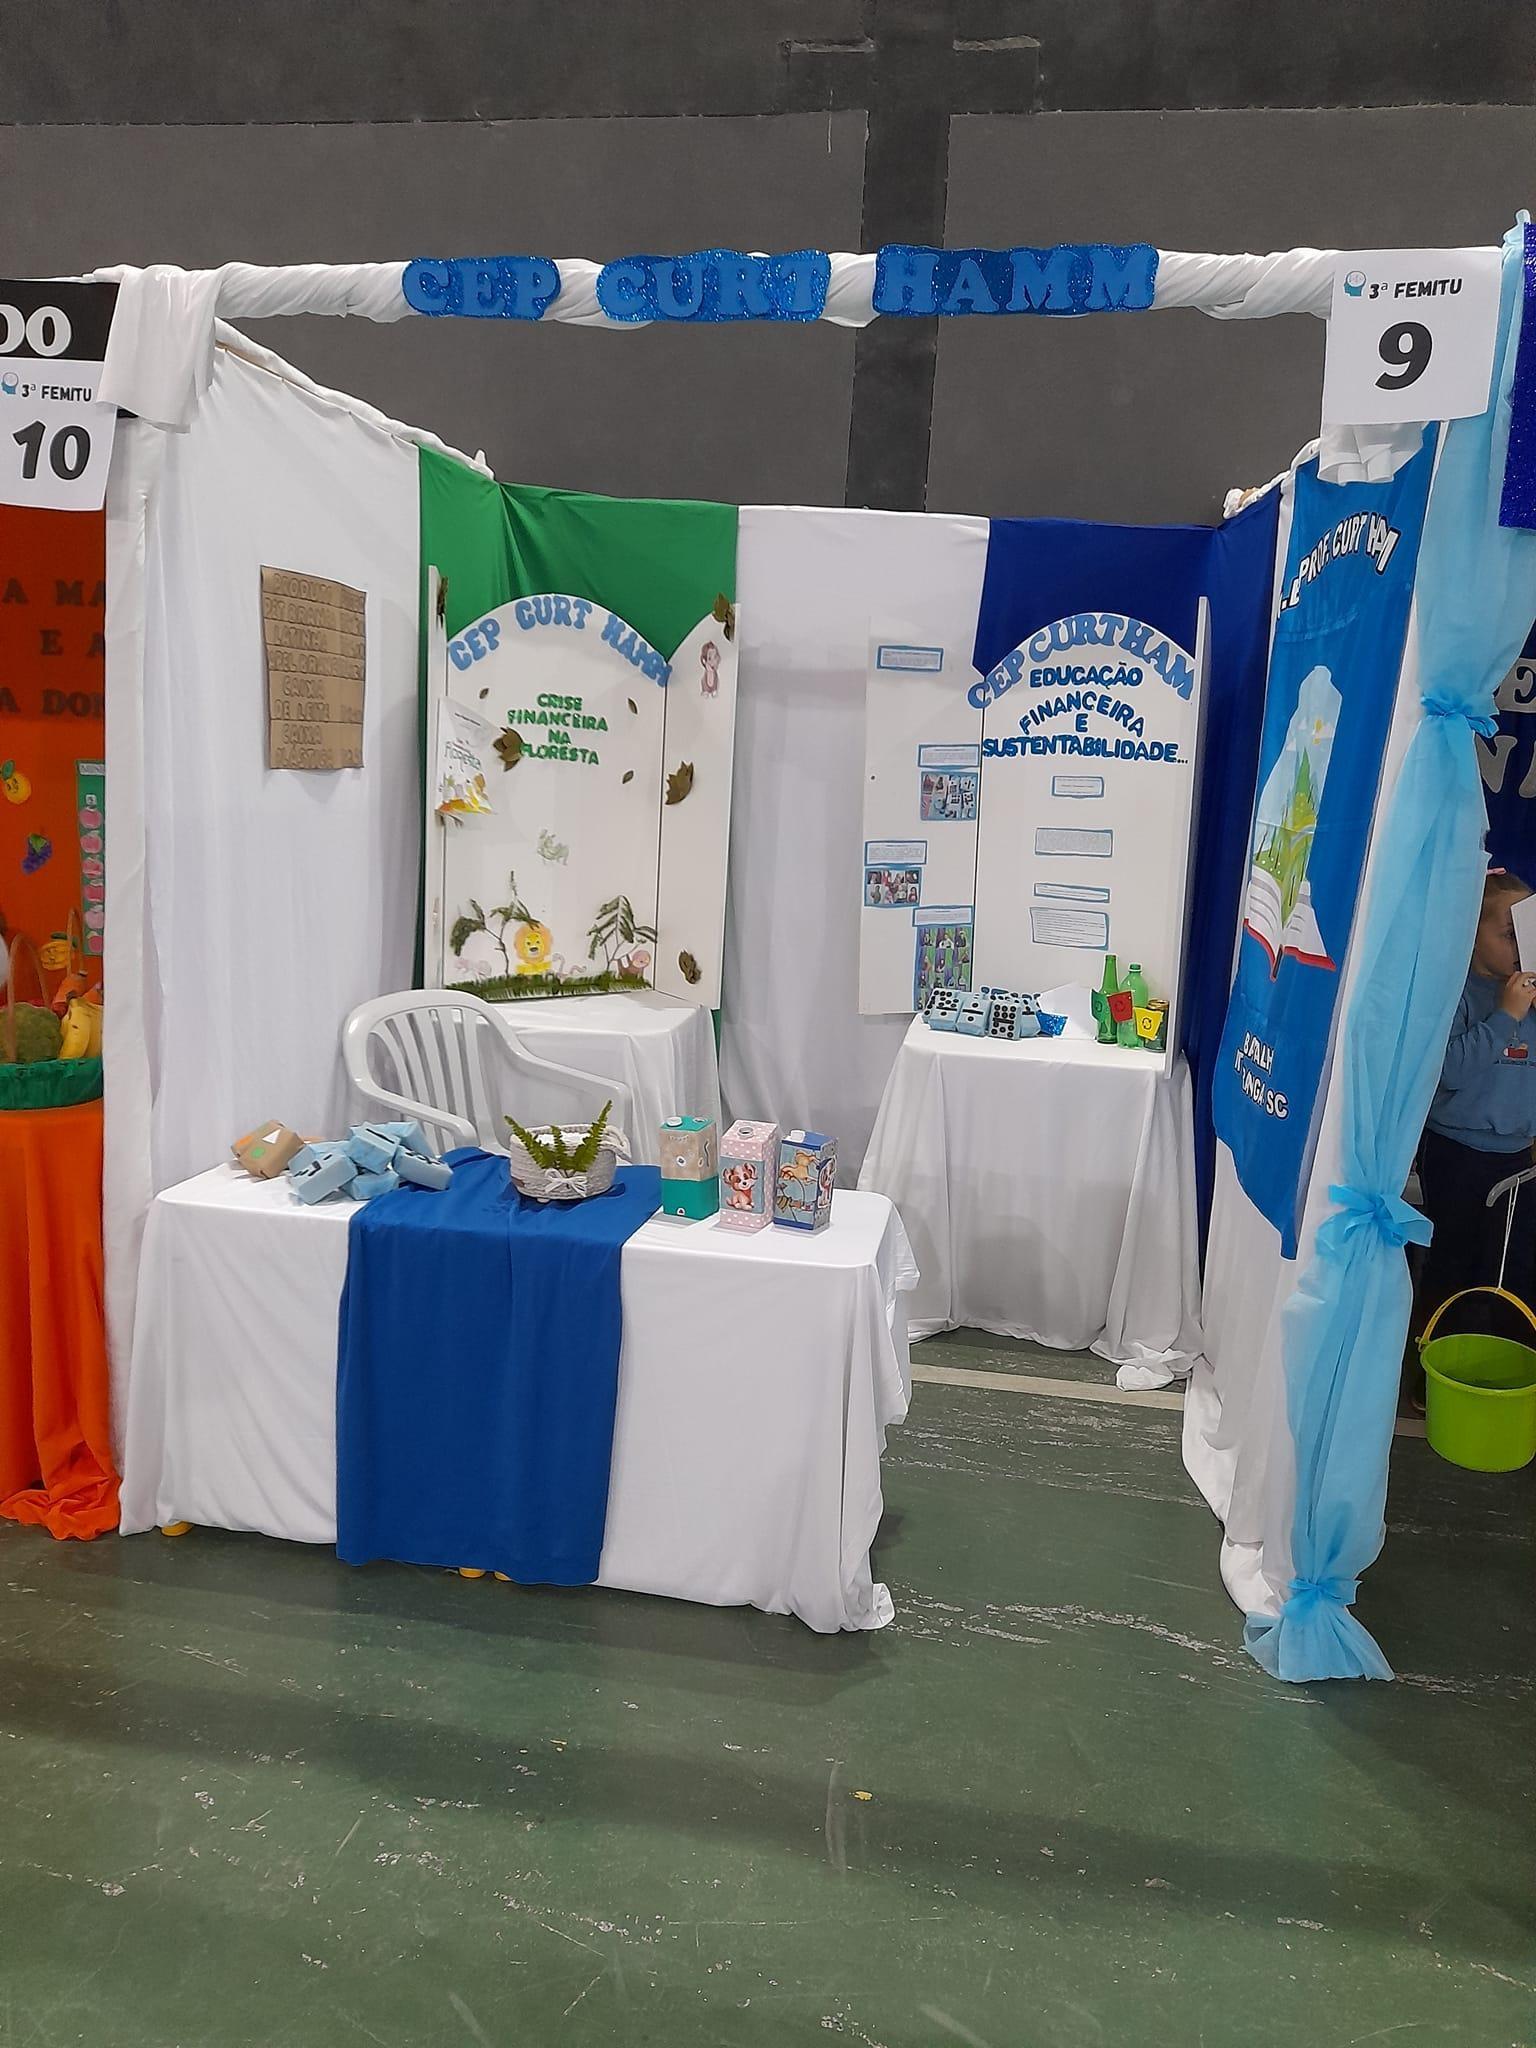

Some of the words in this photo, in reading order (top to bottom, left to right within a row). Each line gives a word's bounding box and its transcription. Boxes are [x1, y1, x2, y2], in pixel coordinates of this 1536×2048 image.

[402, 260, 558, 318] CEP
[597, 252, 826, 318] CURT
[876, 247, 1155, 313] HAMM
[1394, 278, 1463, 299] FEMITU
[1375, 321, 1433, 391] 9
[41, 385, 92, 402] FEMITU
[12, 420, 91, 480] 10
[449, 618, 500, 671] CEP
[515, 596, 592, 630] CURT
[968, 649, 1025, 709] CEP
[1028, 614, 1125, 662] CURT
[1118, 617, 1196, 700] HAM
[1030, 662, 1143, 689] EDUCAÇÃO
[537, 693, 583, 711] CRISE
[1019, 691, 1144, 737] FINANCEIRA
[507, 709, 608, 732] FINANCEIRA
[1076, 714, 1089, 732] E
[548, 728, 572, 745] NA
[520, 743, 600, 765] FLORESTA
